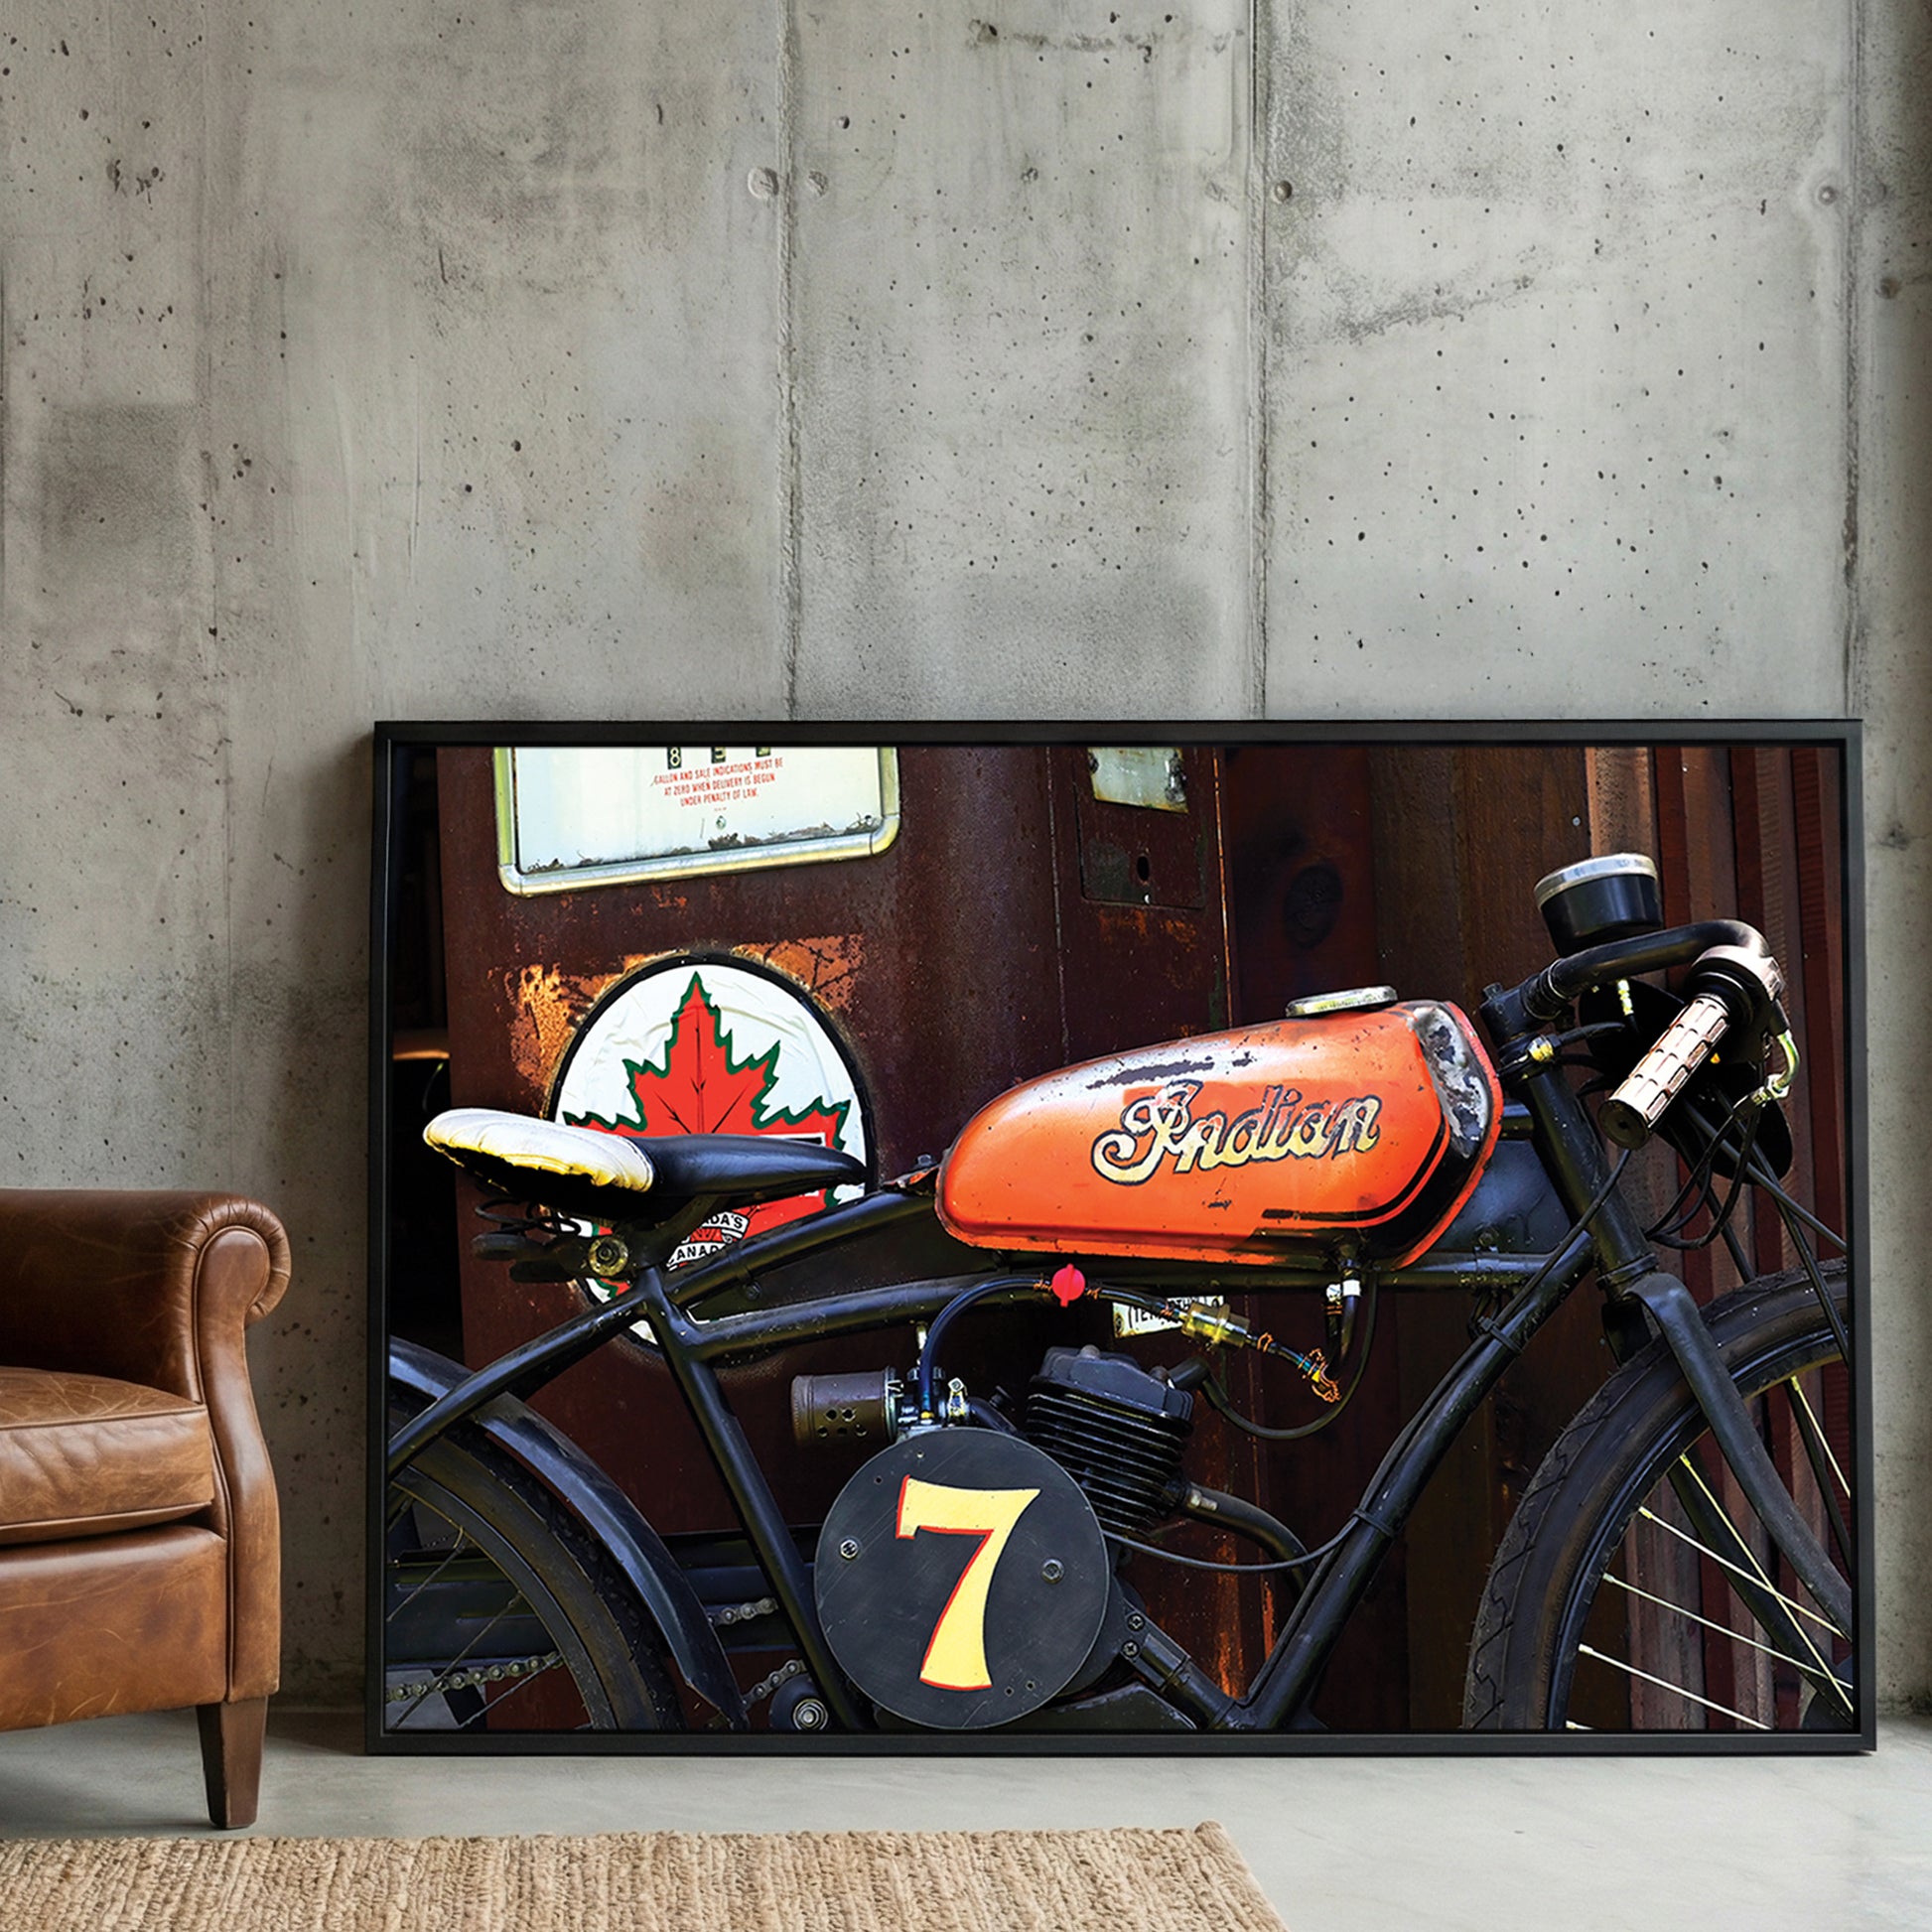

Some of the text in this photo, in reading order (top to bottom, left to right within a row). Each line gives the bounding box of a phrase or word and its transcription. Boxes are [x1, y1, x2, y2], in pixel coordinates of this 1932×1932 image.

[679, 770, 693, 780] AND
[695, 767, 711, 779] SALE
[713, 762, 753, 776] INDICATIONS
[755, 759, 772, 770] MUST
[774, 757, 783, 768] BE
[664, 772, 775, 796] AT ZERO WHEN DELIVERY IS BEGUN
[680, 794, 702, 807] UNDER
[703, 791, 731, 804] PENALTY
[732, 788, 741, 800] OF
[1091, 1078, 1382, 1185] Indian
[895, 1473, 1041, 1691] 7
